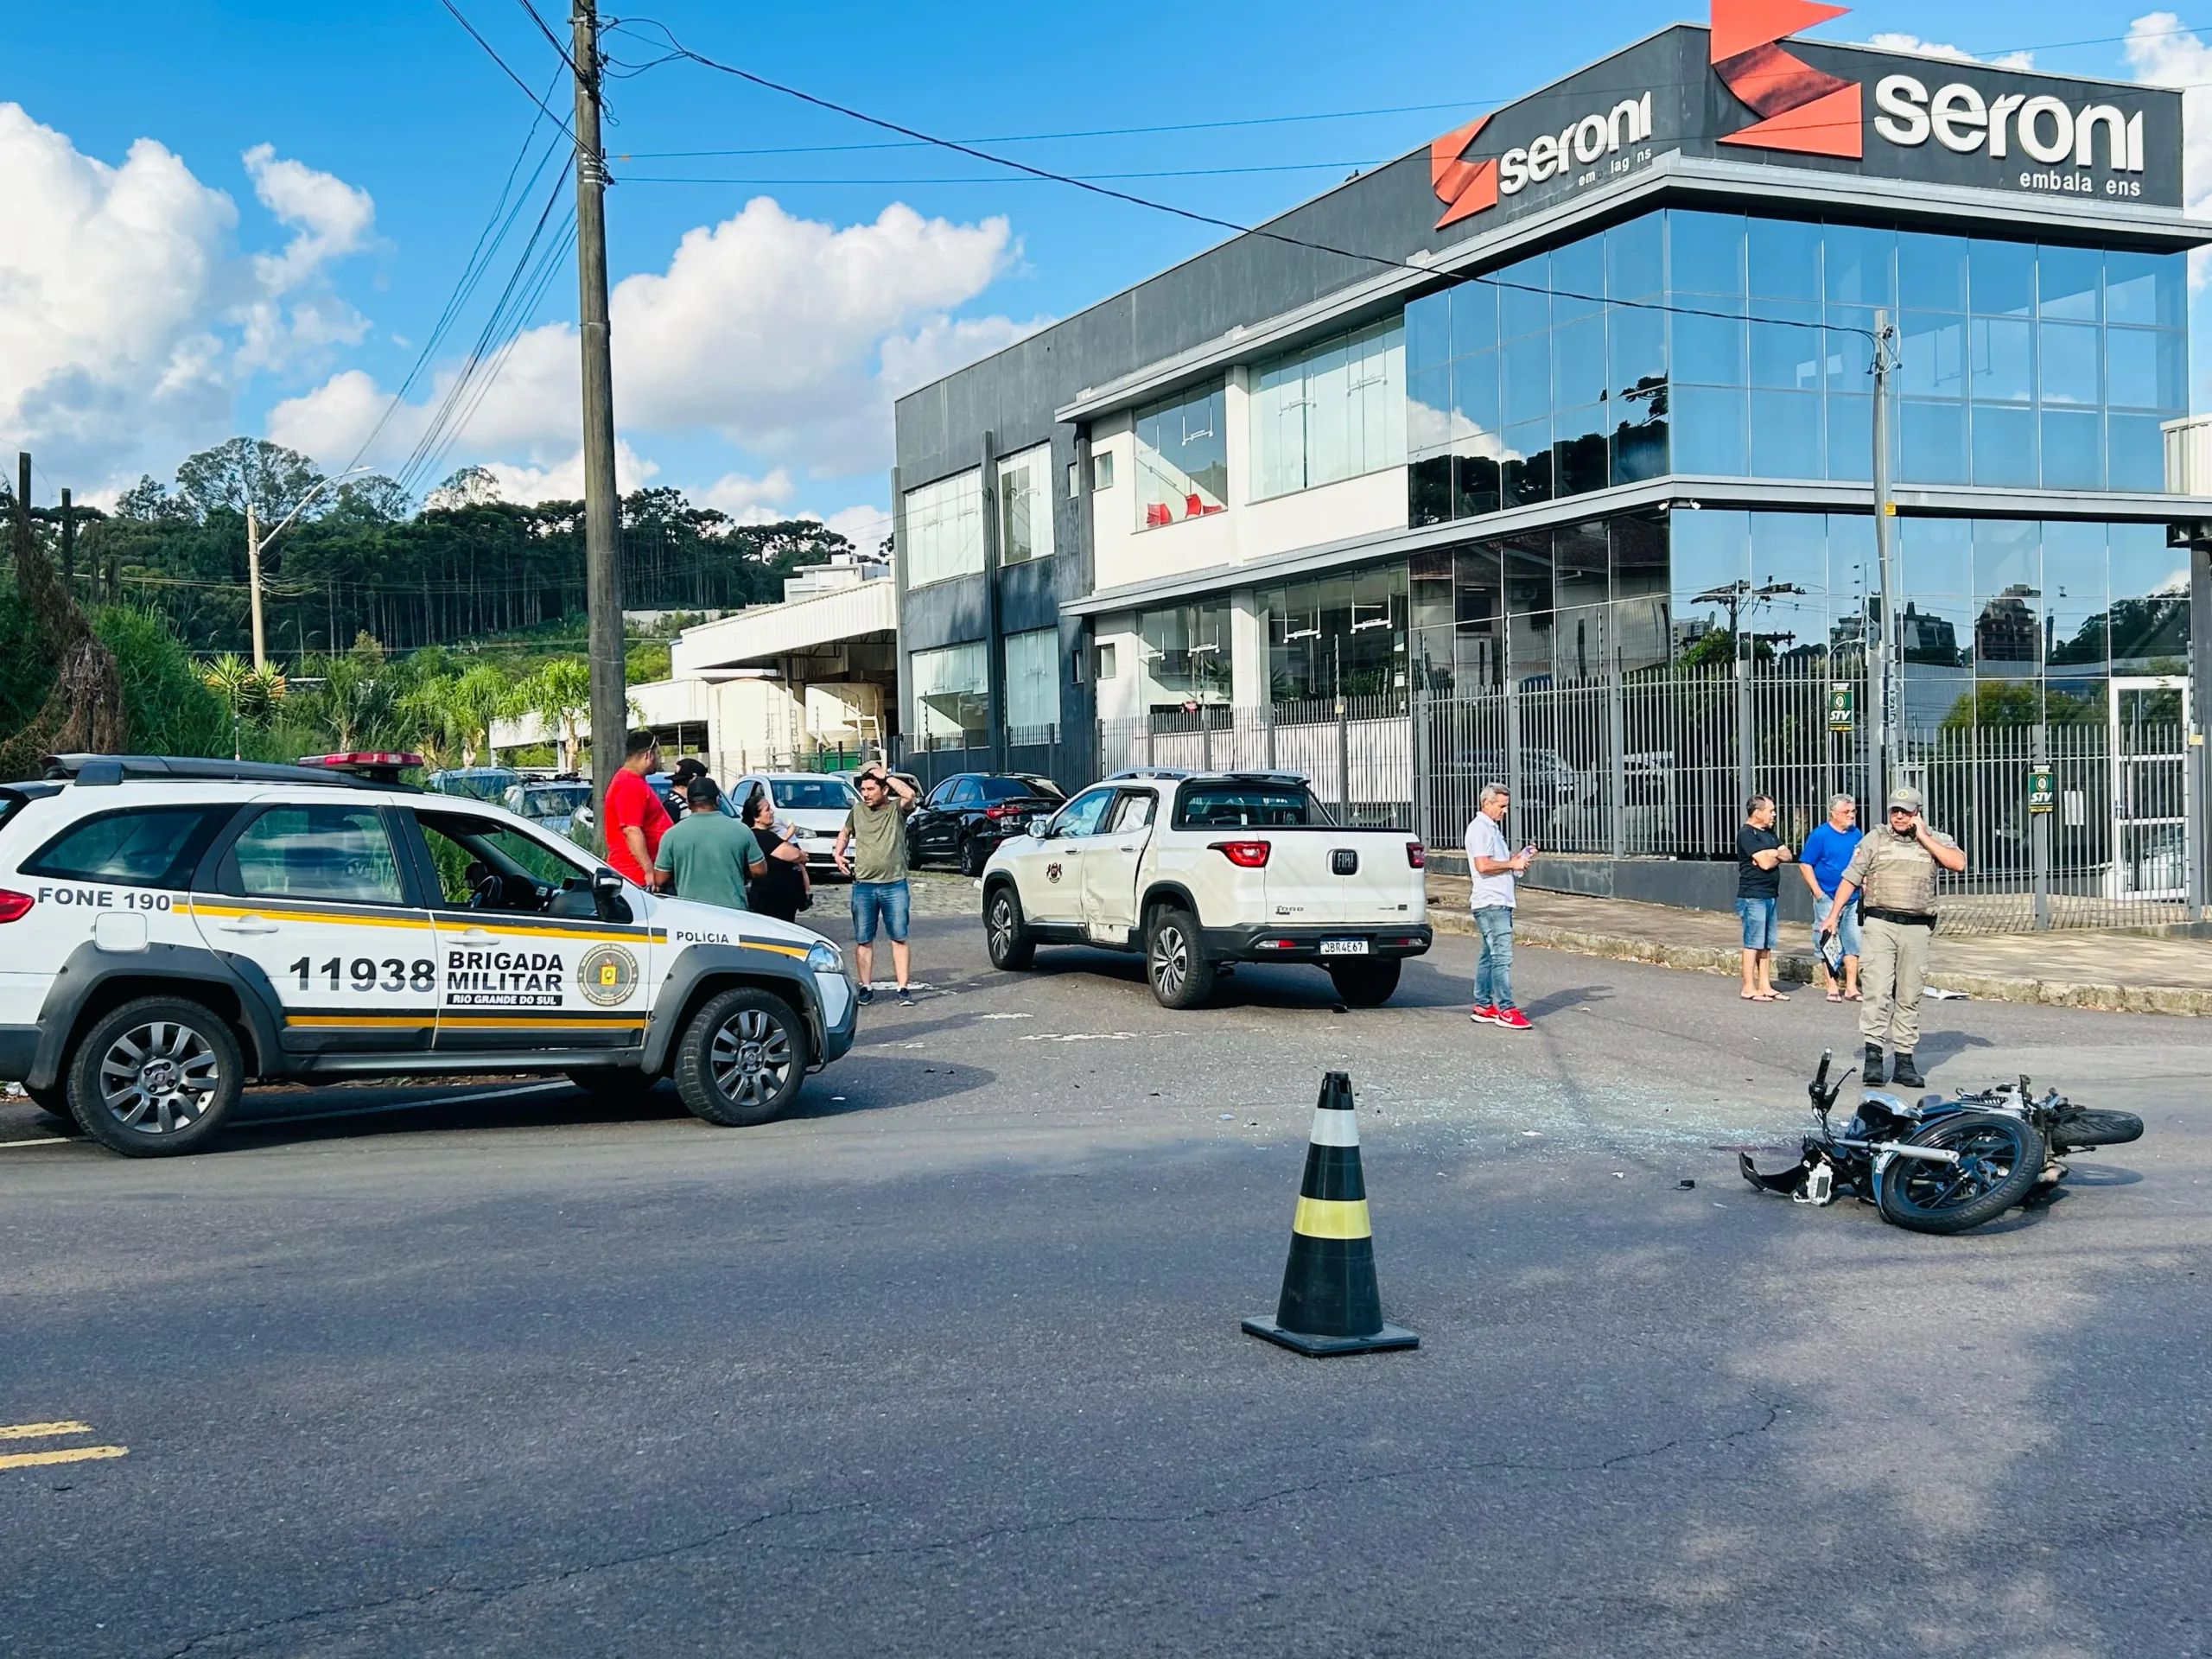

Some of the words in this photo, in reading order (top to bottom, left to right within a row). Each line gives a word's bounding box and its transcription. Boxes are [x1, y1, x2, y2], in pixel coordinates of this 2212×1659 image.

[1874, 74, 2144, 172] seroni
[1500, 91, 1652, 194] seroni
[1829, 710, 1851, 721] STV
[2030, 792, 2052, 803] STV
[1338, 852, 1355, 868] FIAT
[38, 887, 113, 907] FONE
[124, 892, 170, 911] 190
[677, 930, 729, 944] POLÍCIA
[448, 951, 564, 971] BRIGADA
[289, 957, 435, 992] 11938
[447, 972, 563, 991] MILITAR
[453, 995, 472, 1004] RIO
[474, 995, 517, 1005] GRANDE
[519, 995, 533, 1005] DO
[537, 996, 556, 1005] SUL
